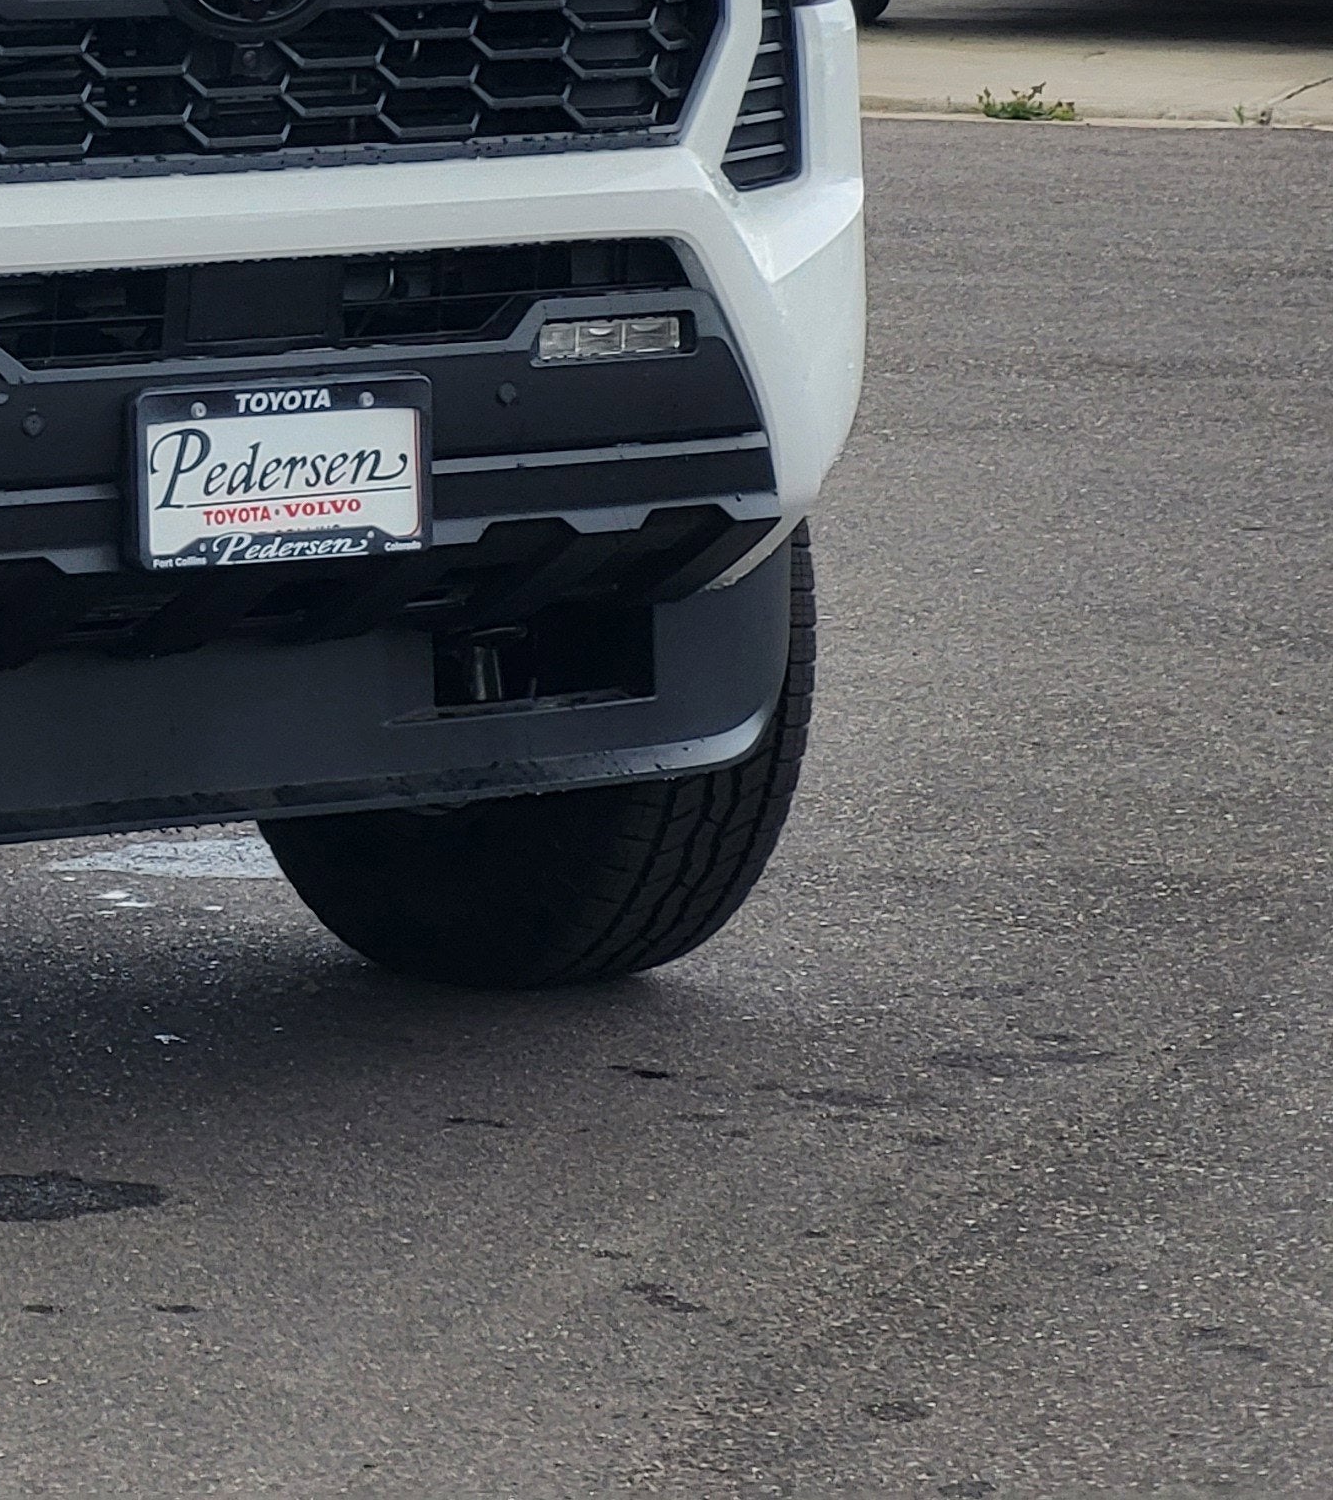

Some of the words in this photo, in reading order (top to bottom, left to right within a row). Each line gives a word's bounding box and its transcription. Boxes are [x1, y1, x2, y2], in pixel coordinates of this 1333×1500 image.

[235, 389, 332, 413] TOYOTA
[150, 428, 408, 510] Pedersen
[203, 506, 272, 526] TOYOTA
[283, 499, 361, 518] VOLVO
[213, 532, 369, 565] Pedersen
